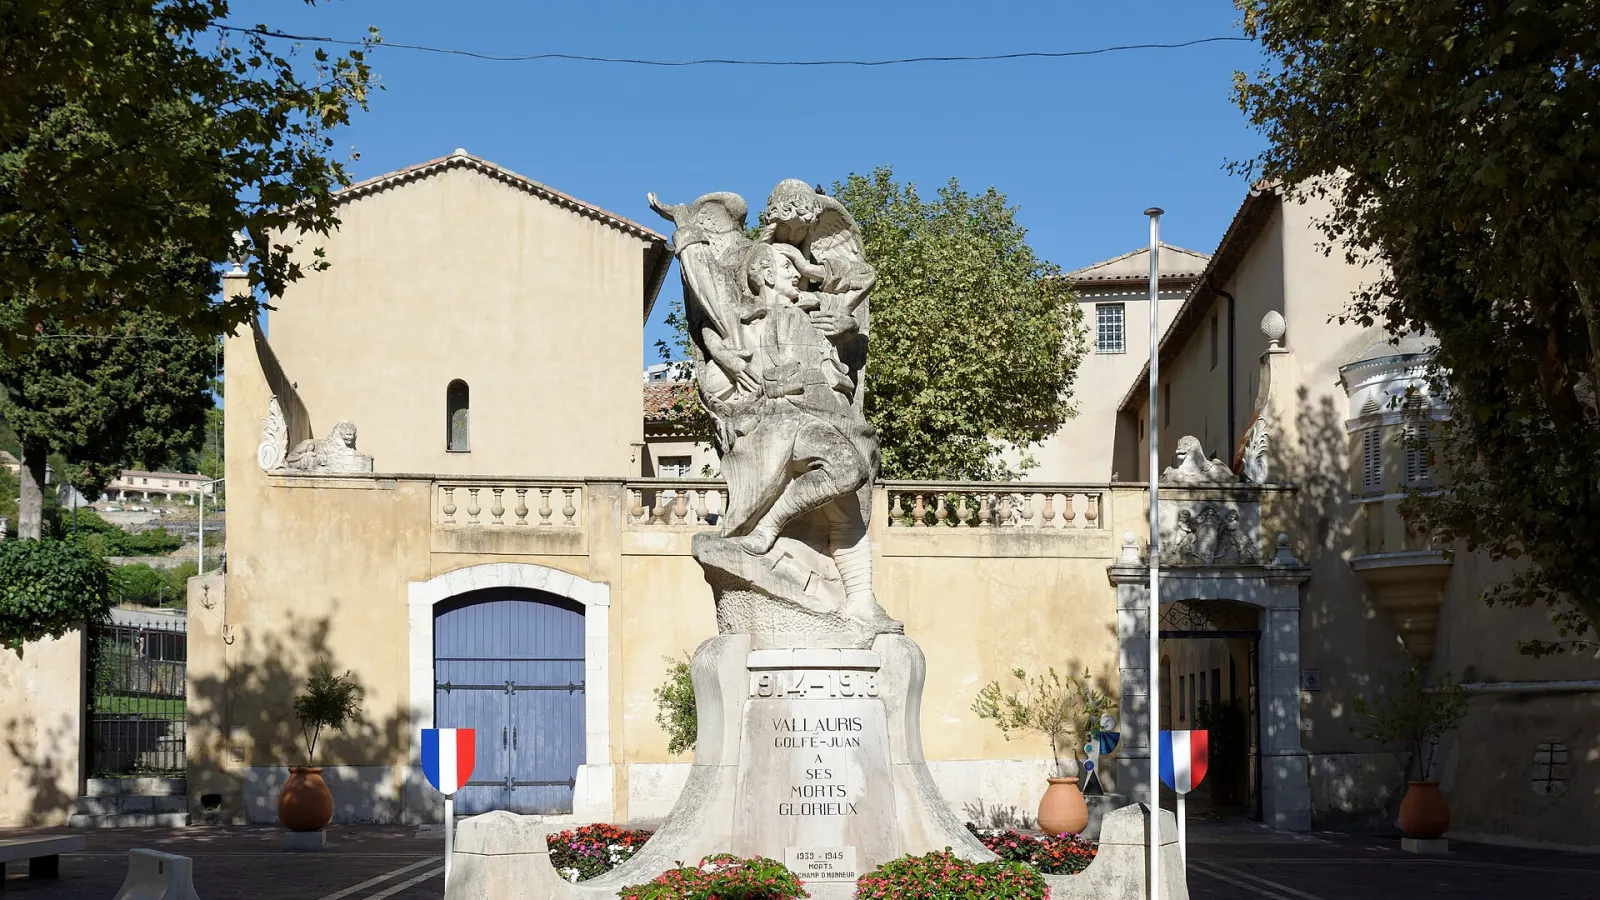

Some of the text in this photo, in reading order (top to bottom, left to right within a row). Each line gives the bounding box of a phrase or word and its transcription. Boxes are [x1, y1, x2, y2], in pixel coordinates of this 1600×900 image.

[748, 673, 879, 698] 1914-1918
[772, 717, 863, 732] VALLAURIS
[774, 736, 861, 748] GOLFE-JUAN
[814, 754, 823, 764] A
[805, 768, 832, 780] SES
[790, 784, 847, 798] MORTS
[779, 802, 858, 816] GLORIEUX
[796, 852, 815, 860] 1939
[824, 851, 844, 860] 1945
